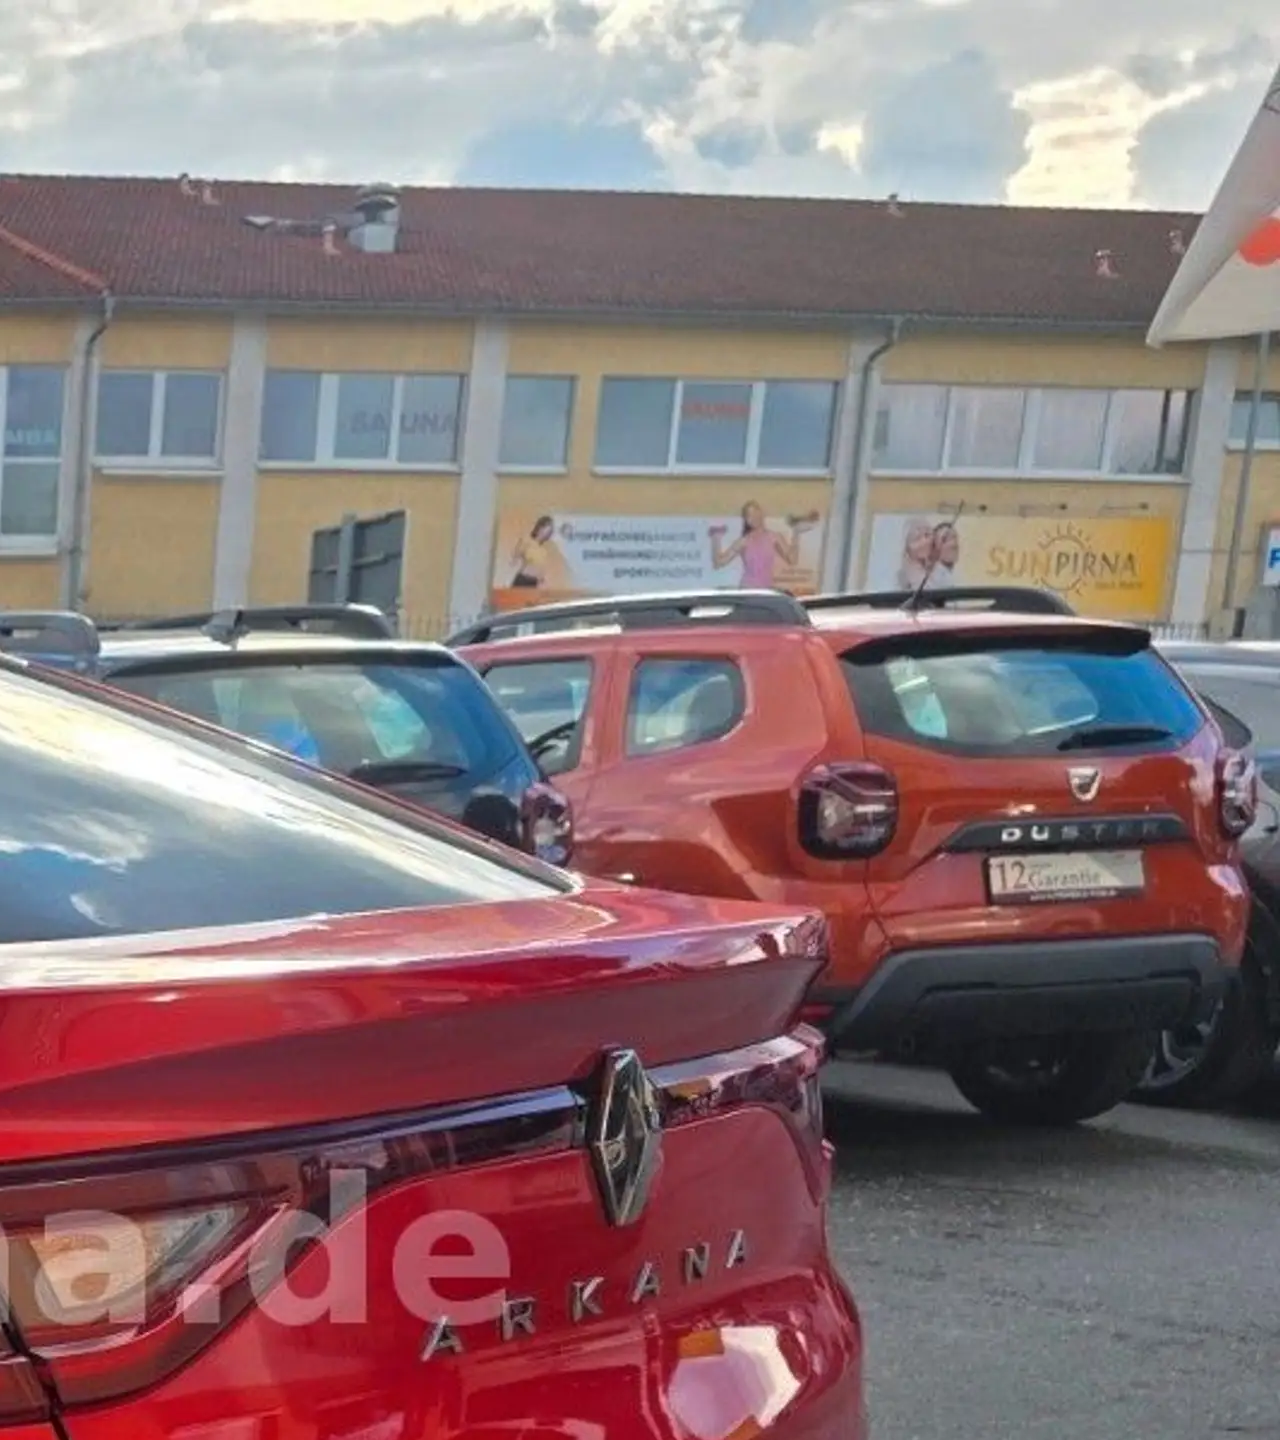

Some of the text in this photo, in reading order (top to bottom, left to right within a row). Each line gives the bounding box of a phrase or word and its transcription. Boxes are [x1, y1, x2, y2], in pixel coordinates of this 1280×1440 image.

[1000, 822, 1160, 843] DUSTER
[995, 860, 1027, 891] 12
[420, 1227, 749, 1362] ARKANA
